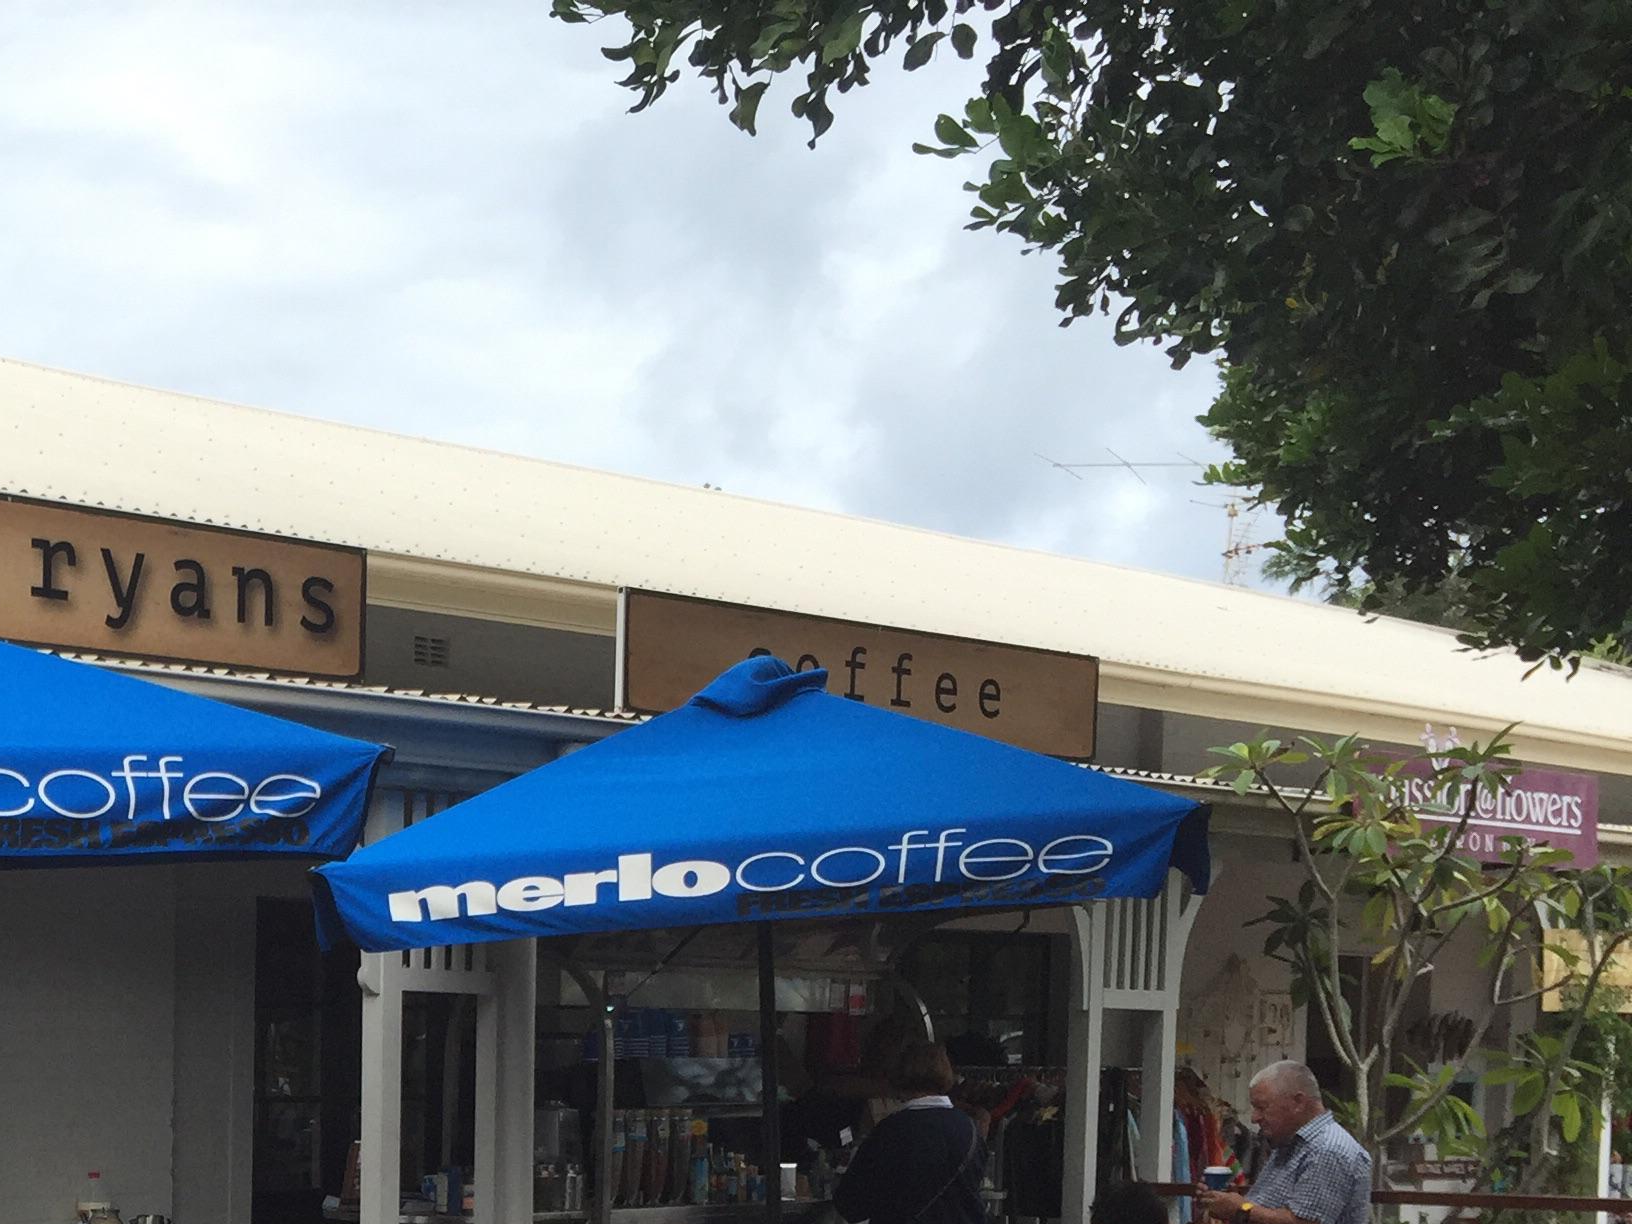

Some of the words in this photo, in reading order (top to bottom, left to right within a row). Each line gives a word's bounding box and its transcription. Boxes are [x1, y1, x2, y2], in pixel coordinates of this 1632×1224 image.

[30, 536, 336, 634] ryans
[747, 647, 1002, 719] ffee
[388, 852, 732, 923] merlo
[734, 827, 1114, 893] coffee
